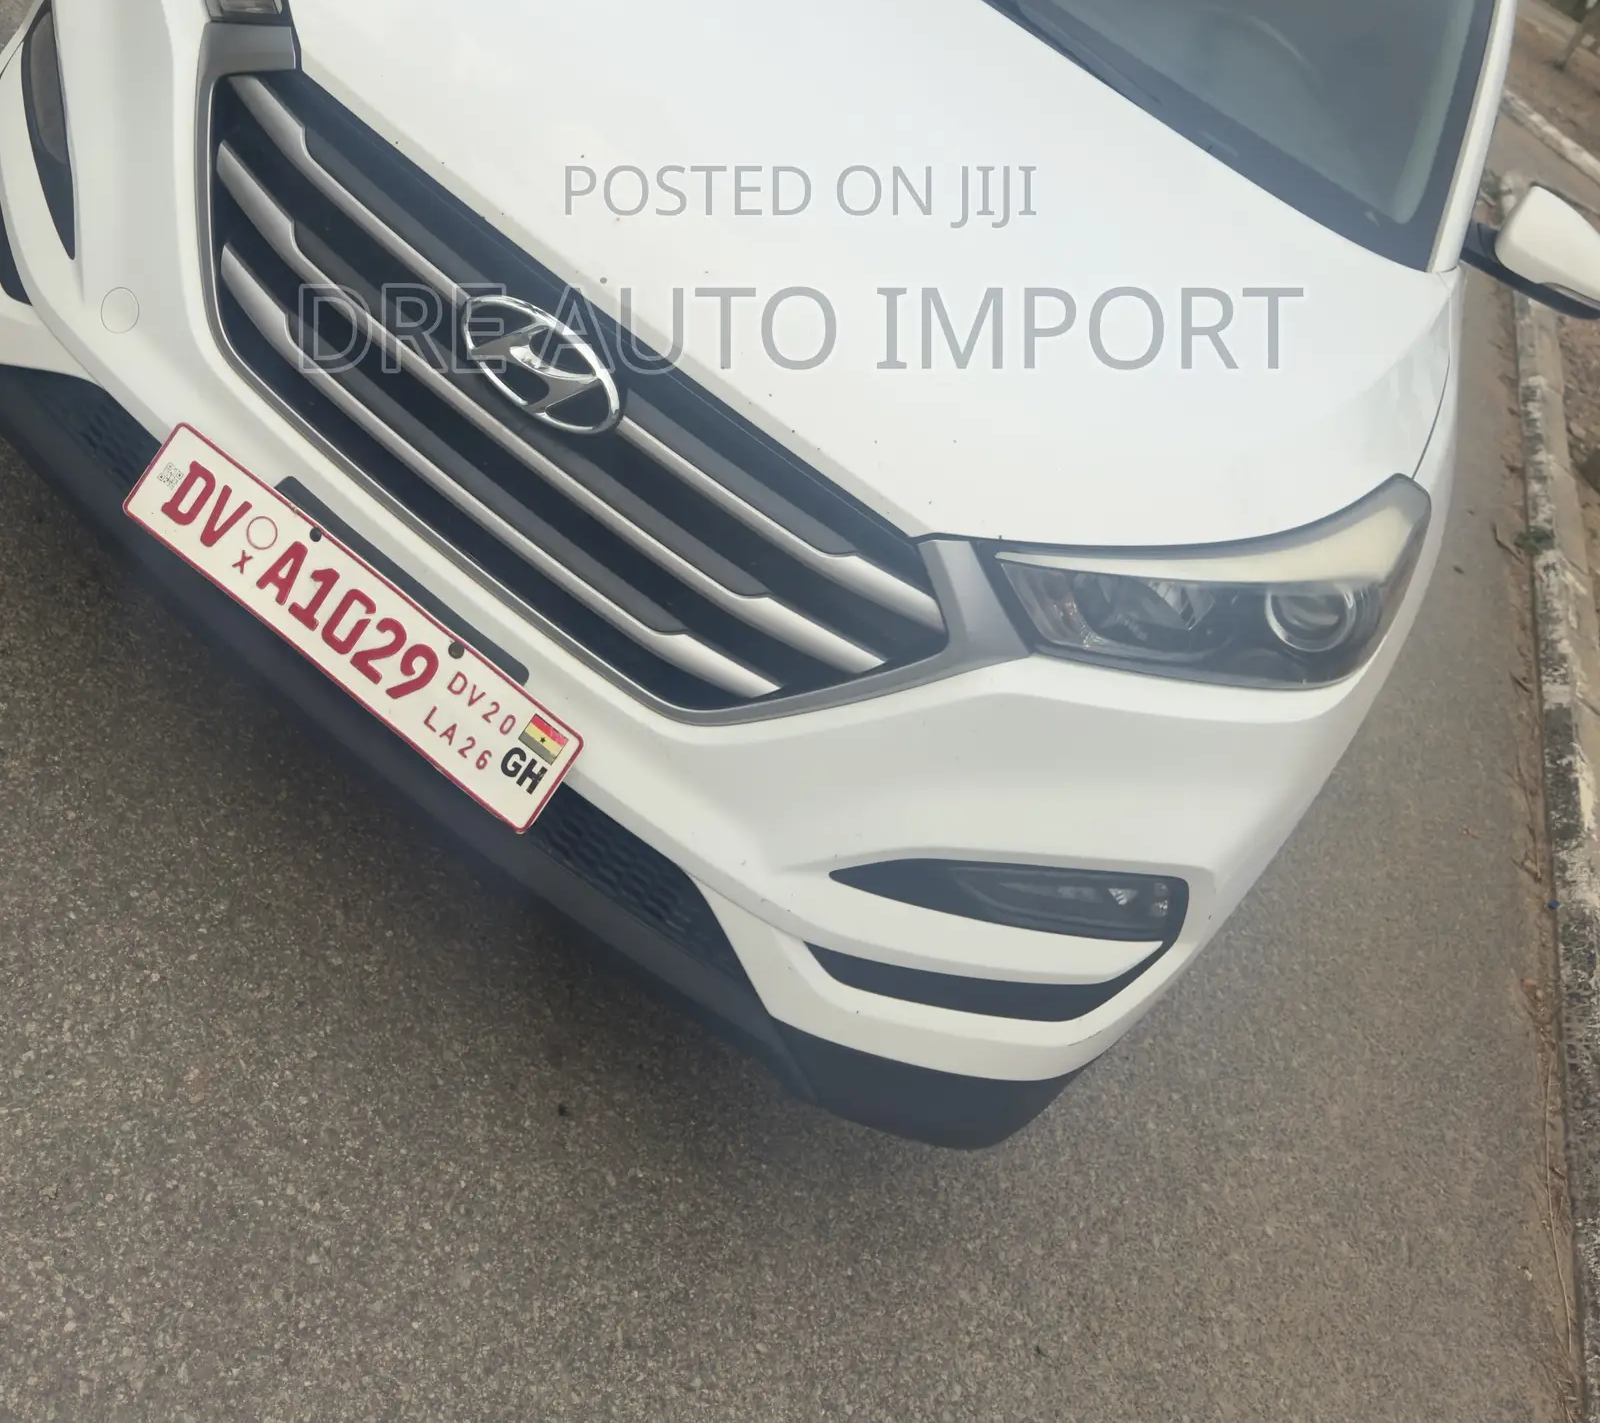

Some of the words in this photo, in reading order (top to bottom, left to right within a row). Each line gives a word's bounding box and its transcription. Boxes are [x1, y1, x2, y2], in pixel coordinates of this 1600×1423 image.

[161, 460, 253, 548] DV
[256, 540, 440, 700] A1029
[447, 671, 517, 736] DV20
[423, 705, 493, 771] LA26
[500, 746, 548, 795] GH
